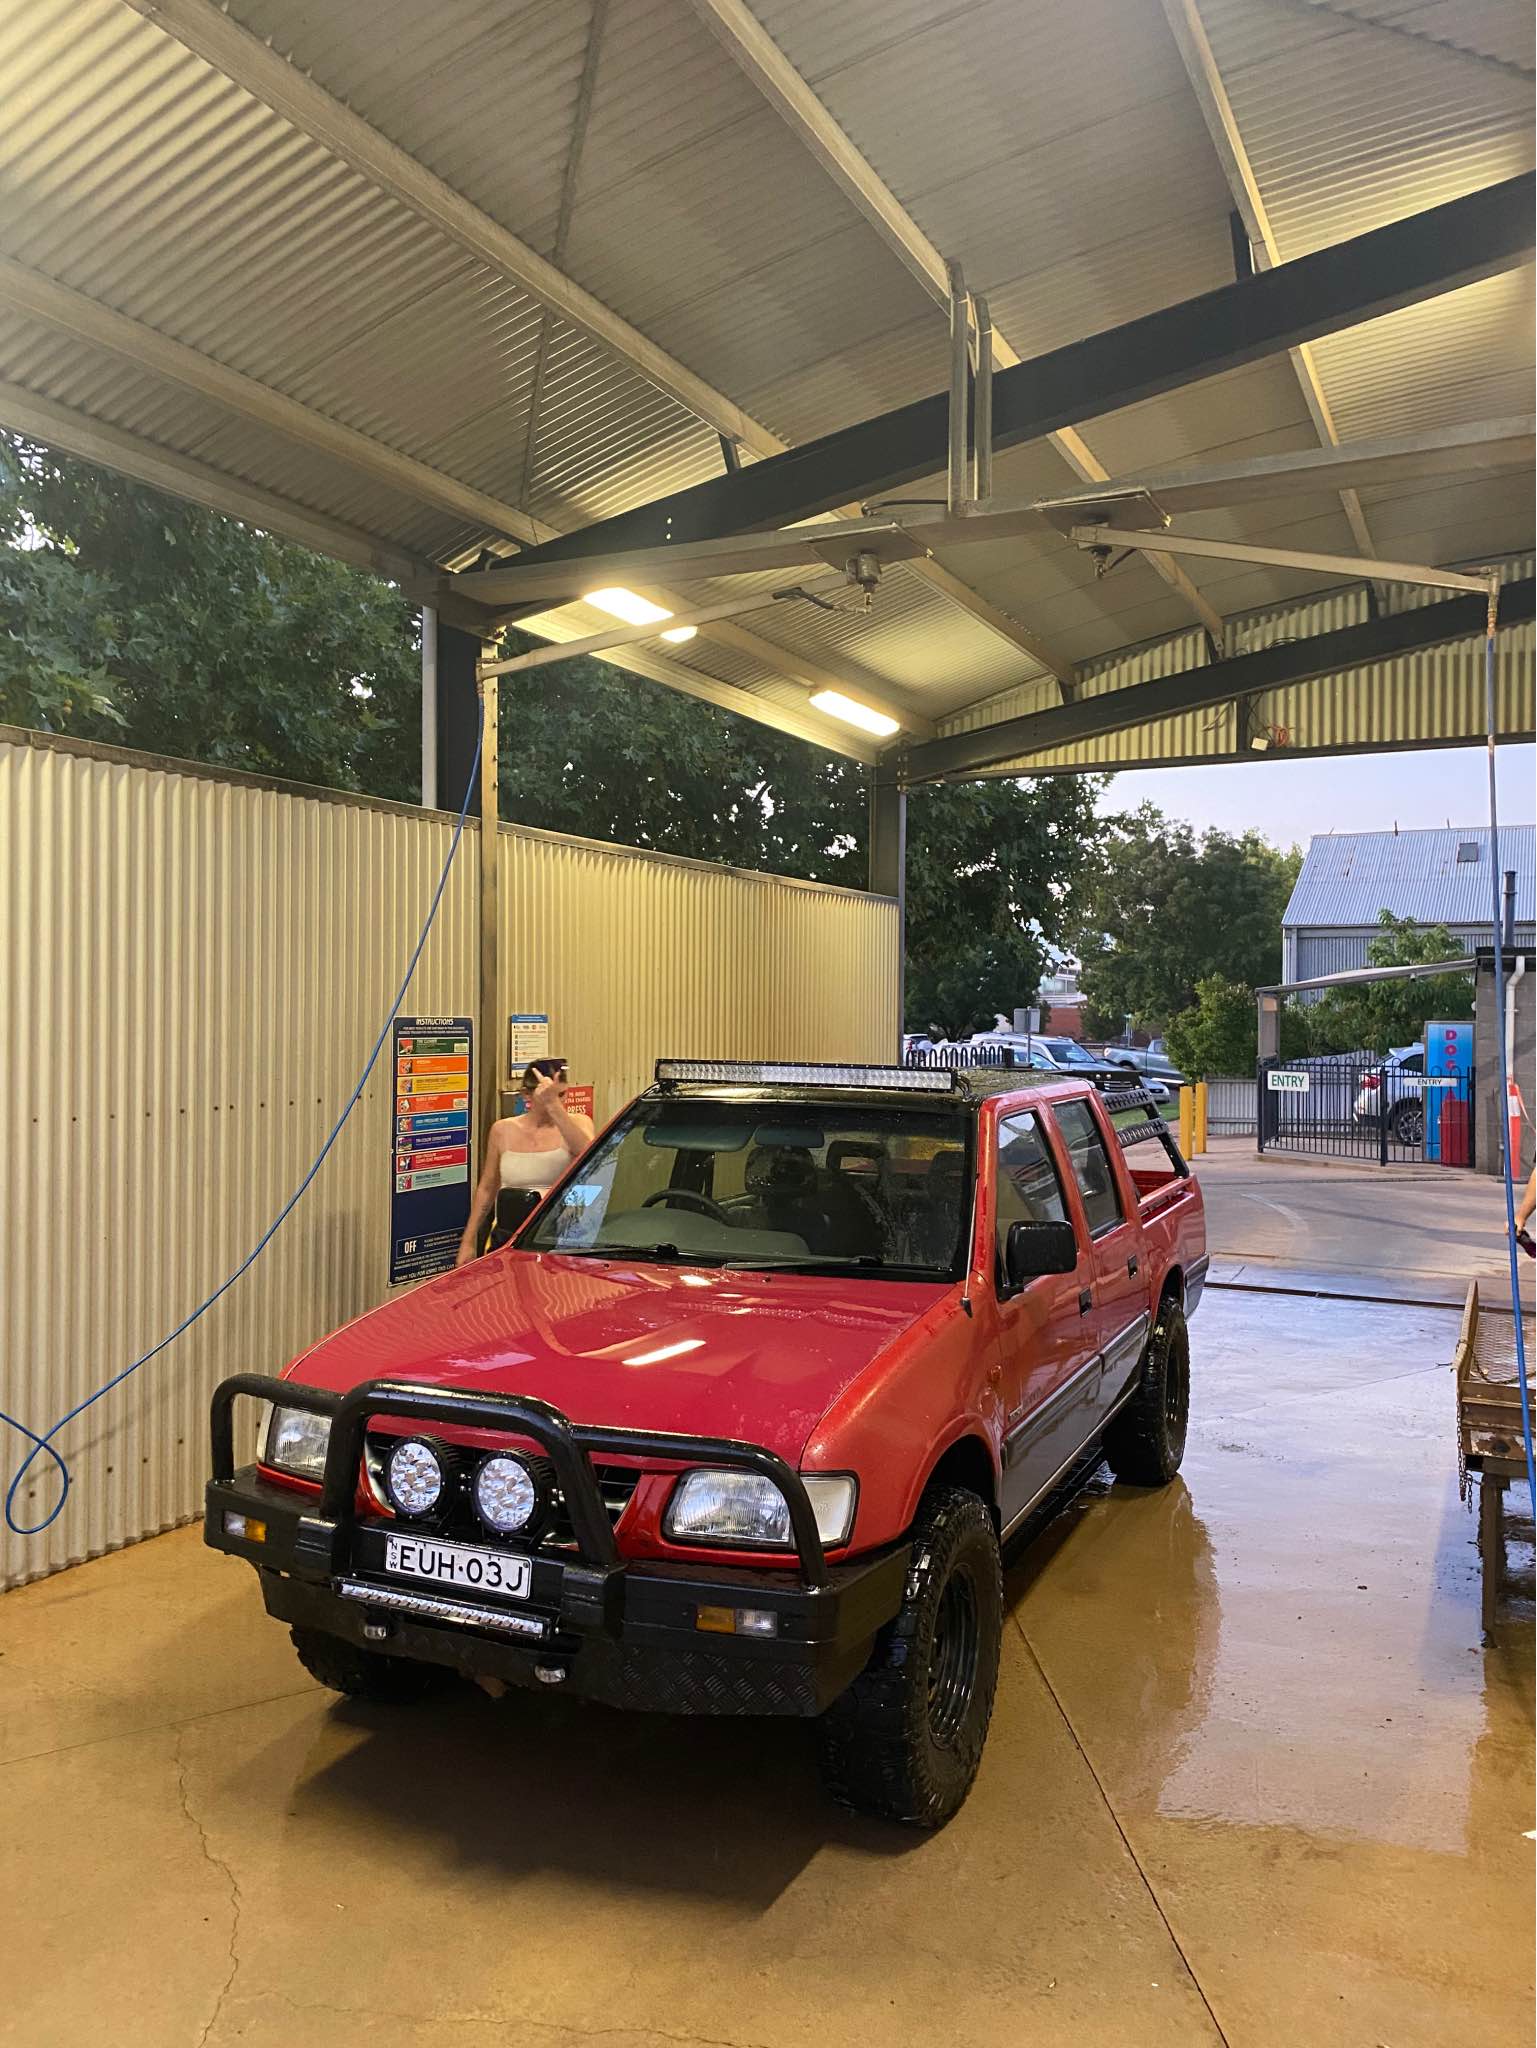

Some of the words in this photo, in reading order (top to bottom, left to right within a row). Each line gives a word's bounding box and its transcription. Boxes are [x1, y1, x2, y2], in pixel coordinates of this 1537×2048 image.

[1271, 1074, 1305, 1088] ENTRY
[568, 1105, 586, 1114] PRESS
[404, 1240, 417, 1254] OFF
[389, 1541, 397, 1568] NSW
